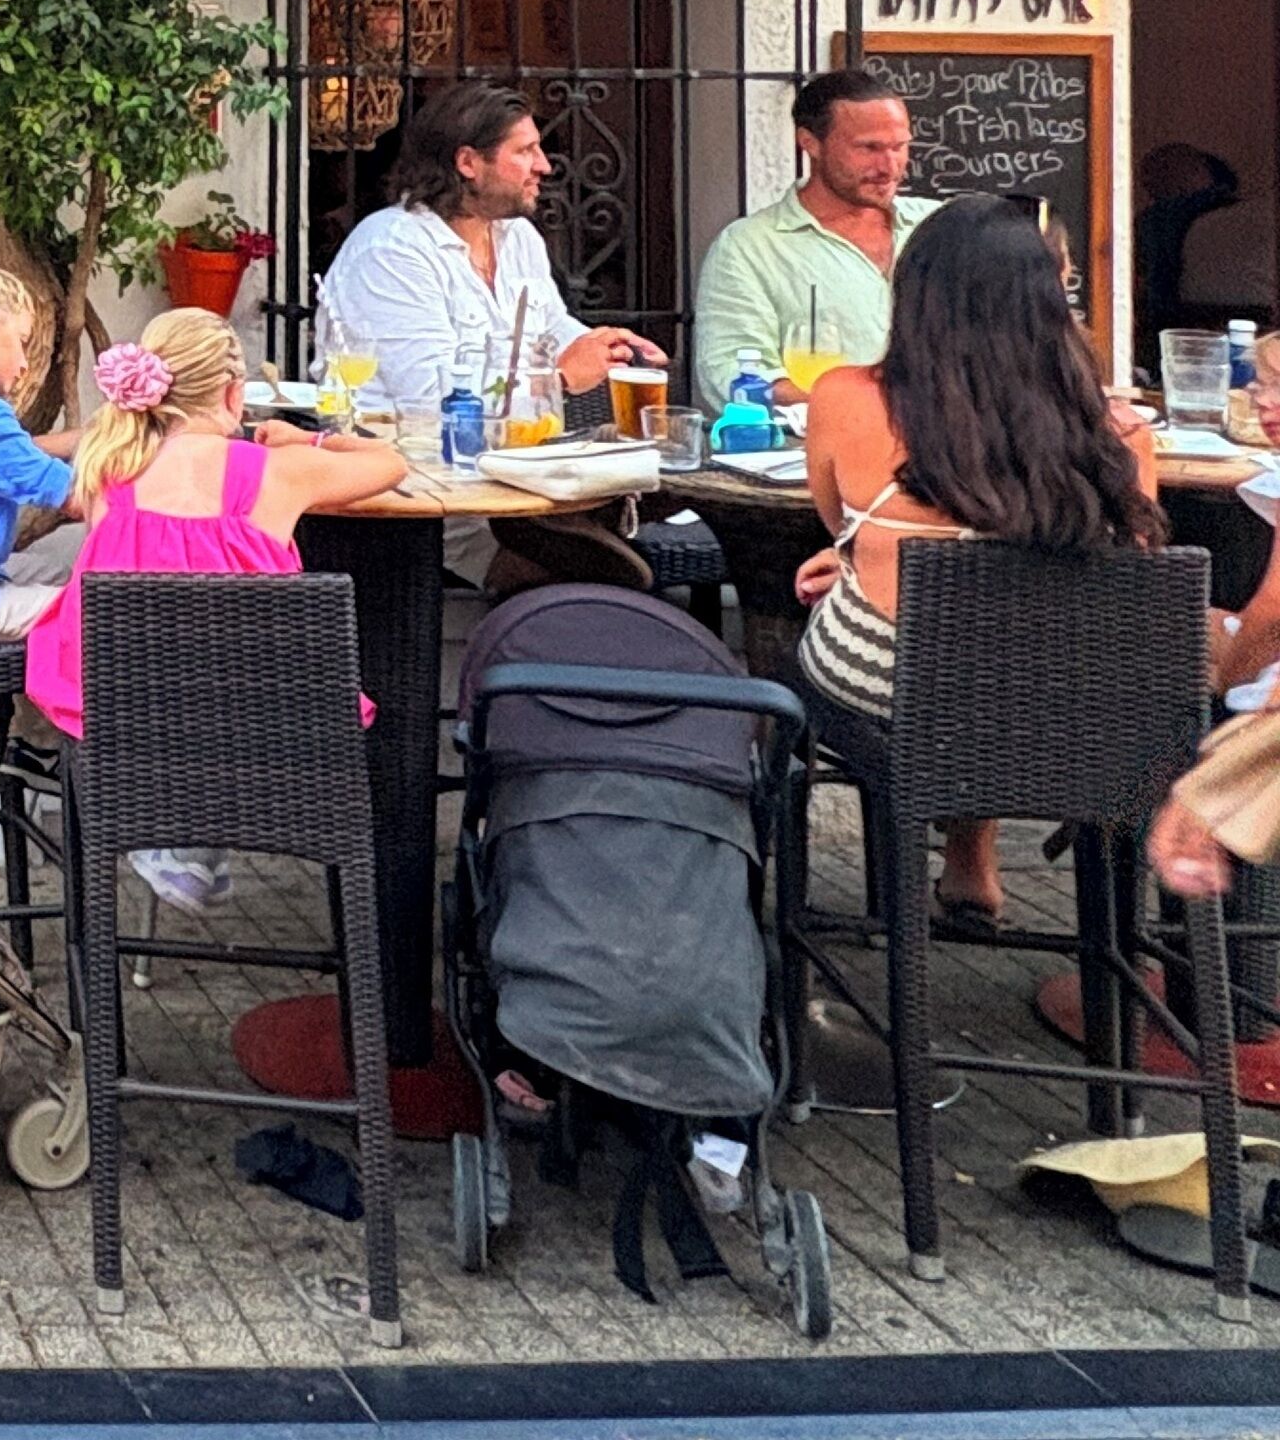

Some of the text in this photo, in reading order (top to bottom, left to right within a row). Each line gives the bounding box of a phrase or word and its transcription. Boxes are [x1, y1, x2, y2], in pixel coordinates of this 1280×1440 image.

[940, 58, 1011, 106] Spare
[1009, 59, 1085, 102] Ribs
[946, 105, 1022, 145] Fish
[1007, 101, 1087, 143] Tacos
[924, 146, 1064, 188] Burgers
